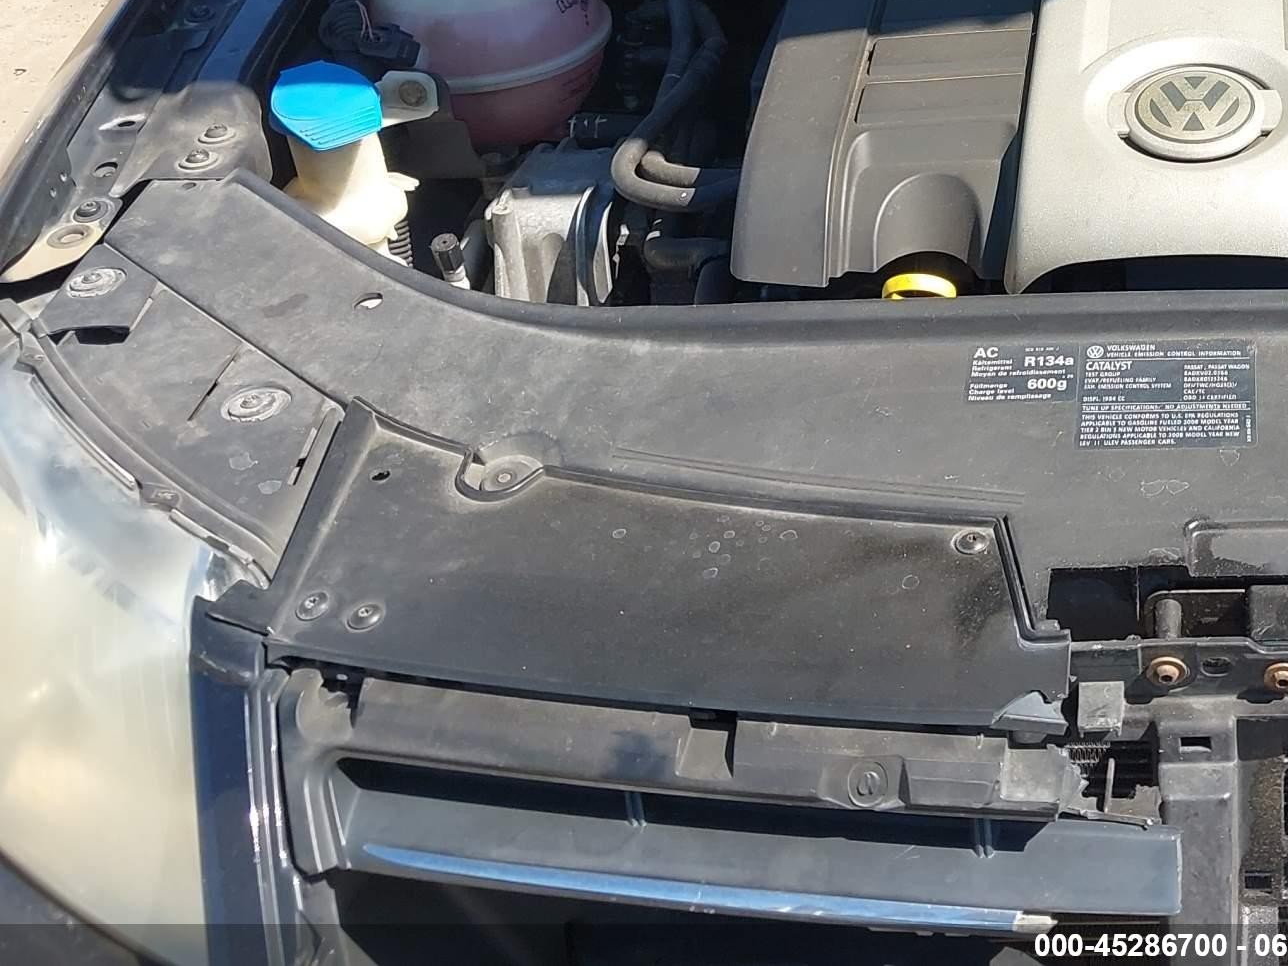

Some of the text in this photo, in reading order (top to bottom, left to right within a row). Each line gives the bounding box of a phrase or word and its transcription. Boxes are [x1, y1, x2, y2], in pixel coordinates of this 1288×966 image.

[974, 347, 998, 358] AC
[1024, 356, 1074, 367] R134a
[1086, 361, 1132, 371] CATALYST
[1027, 378, 1068, 391] 600g
